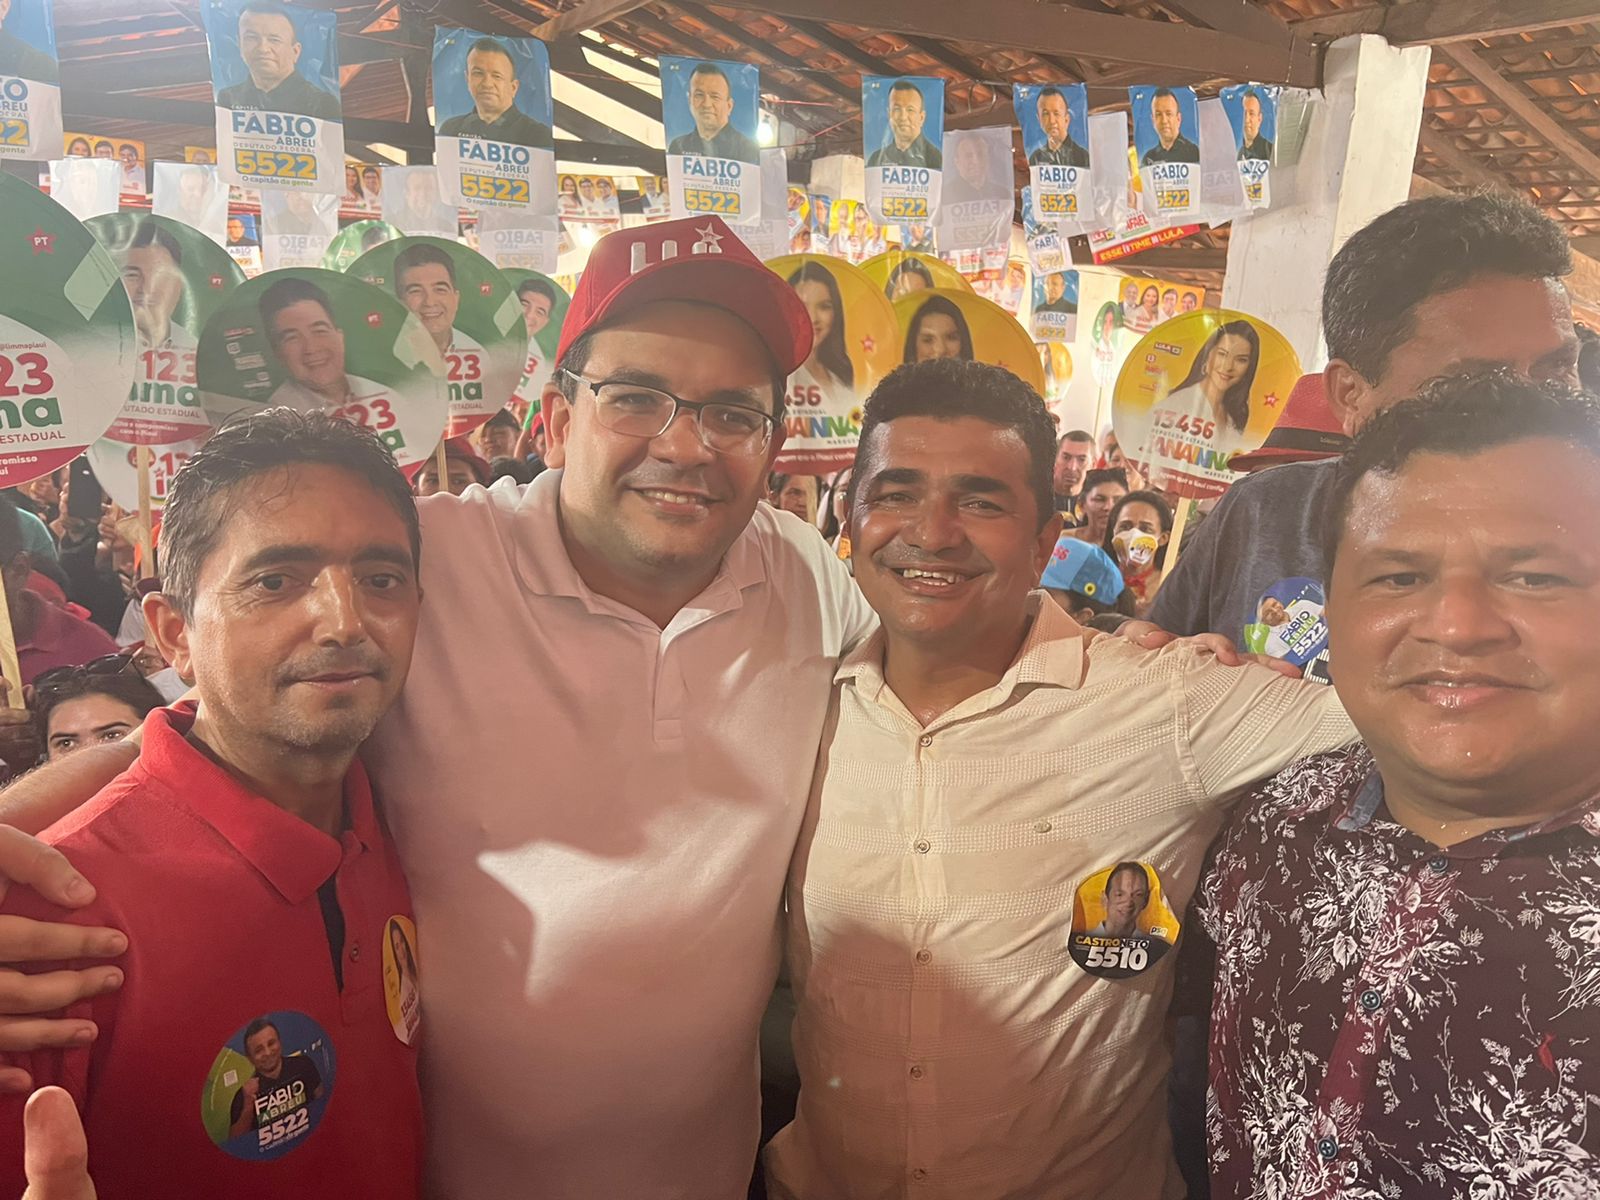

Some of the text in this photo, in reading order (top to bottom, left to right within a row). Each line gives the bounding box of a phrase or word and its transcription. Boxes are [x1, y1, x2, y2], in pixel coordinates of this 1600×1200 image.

[276, 136, 316, 148] ABREU
[236, 149, 318, 180] 5522
[495, 164, 529, 174] ABREU
[462, 174, 530, 202] 5522
[712, 178, 741, 187] ABREU
[685, 189, 741, 214] 5522
[882, 197, 928, 217] 5522
[1040, 194, 1078, 212] 5522
[34, 236, 49, 246] PT
[1130, 237, 1153, 251] TIME
[1159, 227, 1185, 242] LULA
[157, 407, 201, 419] ESTADUAL
[1152, 408, 1216, 440] 13456
[1292, 622, 1326, 657] 5522
[1075, 935, 1121, 947] CASTRO
[1085, 946, 1149, 971] 5510
[259, 1107, 310, 1146] 5522
